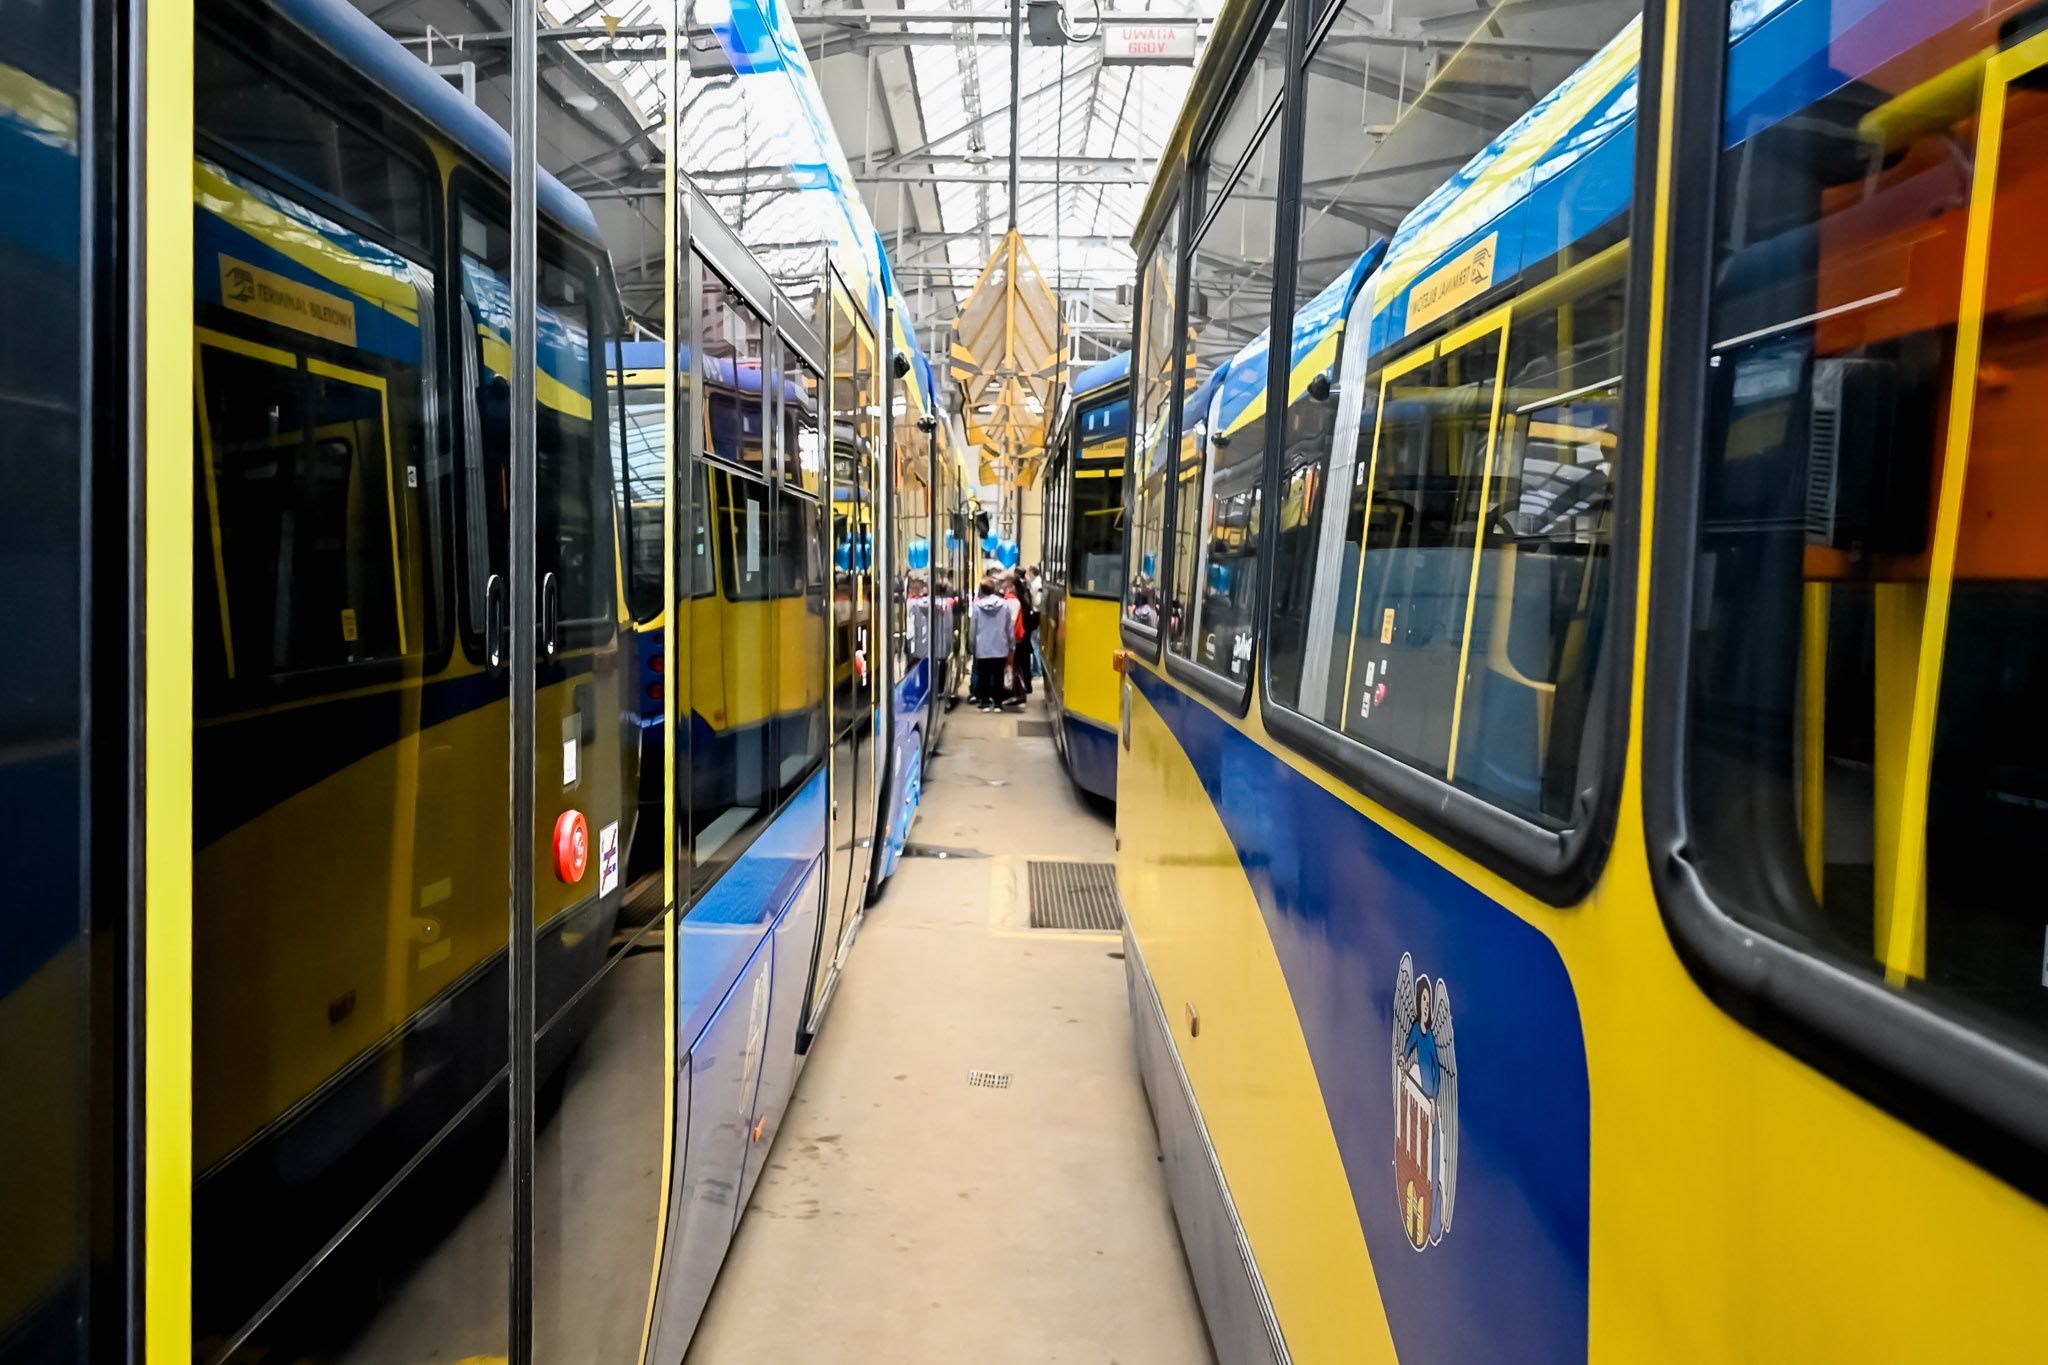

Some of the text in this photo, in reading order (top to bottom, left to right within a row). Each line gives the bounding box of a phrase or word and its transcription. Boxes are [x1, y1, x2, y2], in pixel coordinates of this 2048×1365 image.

[1123, 29, 1175, 40] UWAGA
[257, 283, 353, 329] TERMINAL BILETOWY
